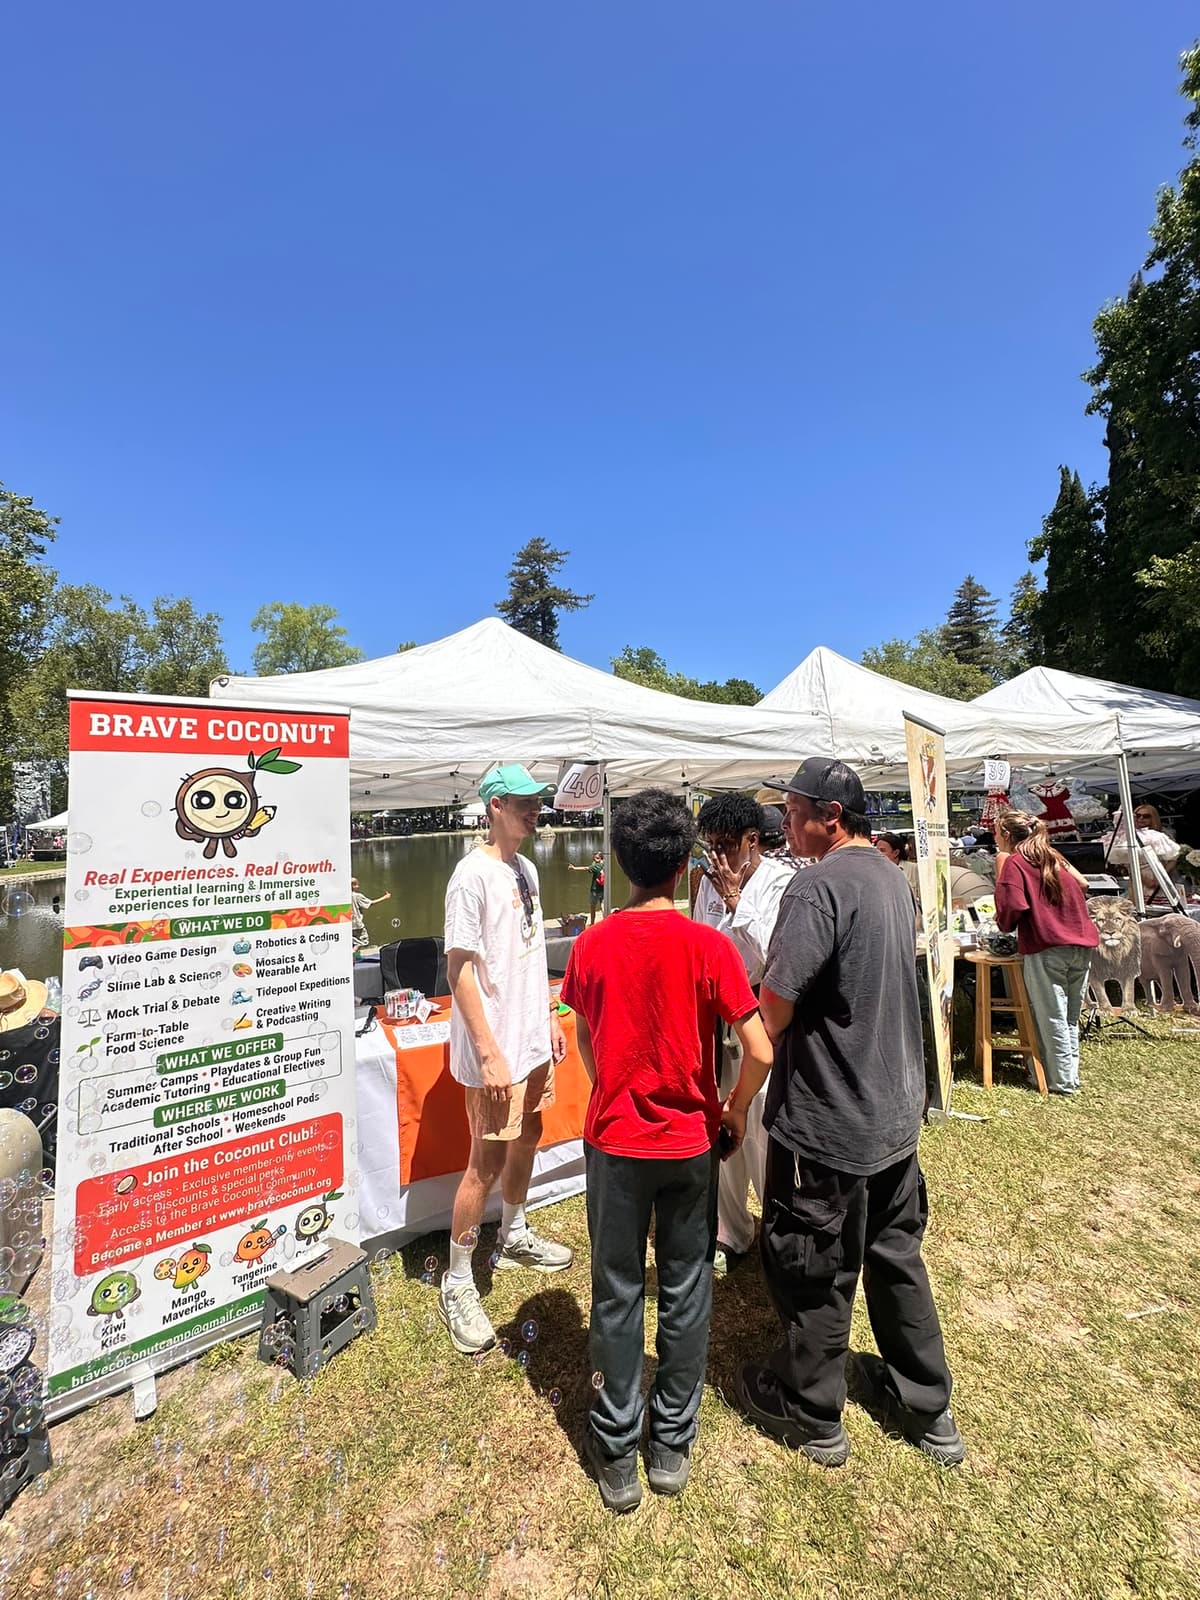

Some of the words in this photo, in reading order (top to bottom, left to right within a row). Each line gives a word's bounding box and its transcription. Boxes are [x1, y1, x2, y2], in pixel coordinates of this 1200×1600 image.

[89, 713, 198, 739] BRAVE
[207, 719, 335, 744] COCONUT
[988, 762, 1006, 780] 39
[563, 773, 601, 798] 40
[84, 869, 126, 886] Real
[131, 866, 239, 885] Experiences.
[245, 862, 278, 877] Real
[284, 860, 336, 875] Growth.
[115, 884, 193, 900] Experiential
[196, 882, 245, 896] learning
[248, 880, 256, 891] &
[259, 877, 315, 890] Immersive
[108, 897, 190, 915] experiences
[193, 896, 210, 907] for
[214, 892, 262, 906] learners
[265, 891, 277, 902] of
[279, 890, 292, 901] all
[295, 890, 320, 903] ages
[179, 919, 220, 935] WHAT
[223, 918, 243, 931] WE
[246, 916, 264, 929] DO
[256, 938, 298, 950] Robotics
[299, 936, 306, 944] &
[309, 931, 340, 946] Coding
[108, 952, 142, 966] Video
[146, 949, 177, 963] Game
[180, 945, 217, 961] Design
[256, 955, 295, 967] Mosaics
[298, 953, 305, 962] &
[107, 980, 141, 993] Slime
[144, 977, 165, 988] Lab
[168, 975, 175, 985] &
[178, 969, 222, 983] Science
[256, 965, 300, 979] Wearable
[302, 963, 317, 973] Art
[256, 984, 297, 998] Tidepool
[300, 975, 350, 992] Expeditions
[107, 1008, 139, 1020] Mock
[143, 1003, 169, 1015] Trial
[171, 1001, 179, 1011] &
[182, 995, 220, 1009] Debate
[256, 1004, 296, 1017] Creative
[298, 998, 331, 1013] Writing
[256, 1020, 263, 1029] &
[265, 1011, 319, 1028] Podcasting
[106, 1021, 189, 1043] Farm-to-Table
[106, 1042, 136, 1056] Food
[139, 1034, 184, 1050] Science
[165, 1052, 209, 1070] WHAT
[211, 1046, 233, 1060] WE
[236, 1038, 276, 1057] OFFER
[107, 1080, 157, 1099] Summer
[160, 1073, 199, 1090] Camps
[211, 1059, 262, 1078] Playdates
[264, 1057, 271, 1066] &
[273, 1050, 302, 1065] Group
[305, 1046, 321, 1058] Fun
[101, 1093, 161, 1114] Academic
[164, 1082, 211, 1102] Tutoring
[222, 1067, 281, 1088] Educational
[284, 1057, 325, 1073] Electives
[161, 1102, 212, 1122] WHERE
[216, 1095, 238, 1108] WE
[241, 1085, 280, 1103] WORK
[109, 1127, 174, 1153] Traditional
[177, 1117, 220, 1136] Schools
[232, 1101, 294, 1122] Homeschool
[296, 1093, 320, 1106] Pods
[153, 1140, 184, 1155] After
[186, 1129, 223, 1148] School
[235, 1113, 286, 1134] Weekends
[143, 1168, 179, 1187] Join
[184, 1159, 209, 1174] the
[214, 1140, 275, 1166] Coconut
[278, 1126, 314, 1147] Club!
[99, 1198, 129, 1217] Early
[133, 1186, 172, 1208] access
[182, 1171, 231, 1193] Exclusive
[233, 1152, 294, 1176] member-only
[297, 1143, 326, 1159] events
[154, 1188, 209, 1212] Discounts
[211, 1182, 218, 1194] &
[221, 1173, 256, 1193] special
[259, 1166, 285, 1181] perks
[110, 1221, 153, 1239] Access
[156, 1215, 166, 1225] to
[170, 1209, 187, 1221] the
[190, 1199, 220, 1215] Brave
[222, 1184, 264, 1203] Coconut
[266, 1166, 317, 1192] community
[91, 1238, 143, 1265] Become
[145, 1235, 153, 1244] a
[156, 1220, 203, 1242] Member
[206, 1215, 217, 1226] at
[219, 1177, 332, 1221] www.bravecoconut.org
[232, 1260, 278, 1286] Tangerine
[162, 1297, 215, 1325] Mavericks
[171, 1289, 207, 1309] Mango
[101, 1320, 126, 1339] Kiwi
[101, 1334, 126, 1350] Kids
[71, 1300, 258, 1389] bravecoconutcamp@gmail.com
